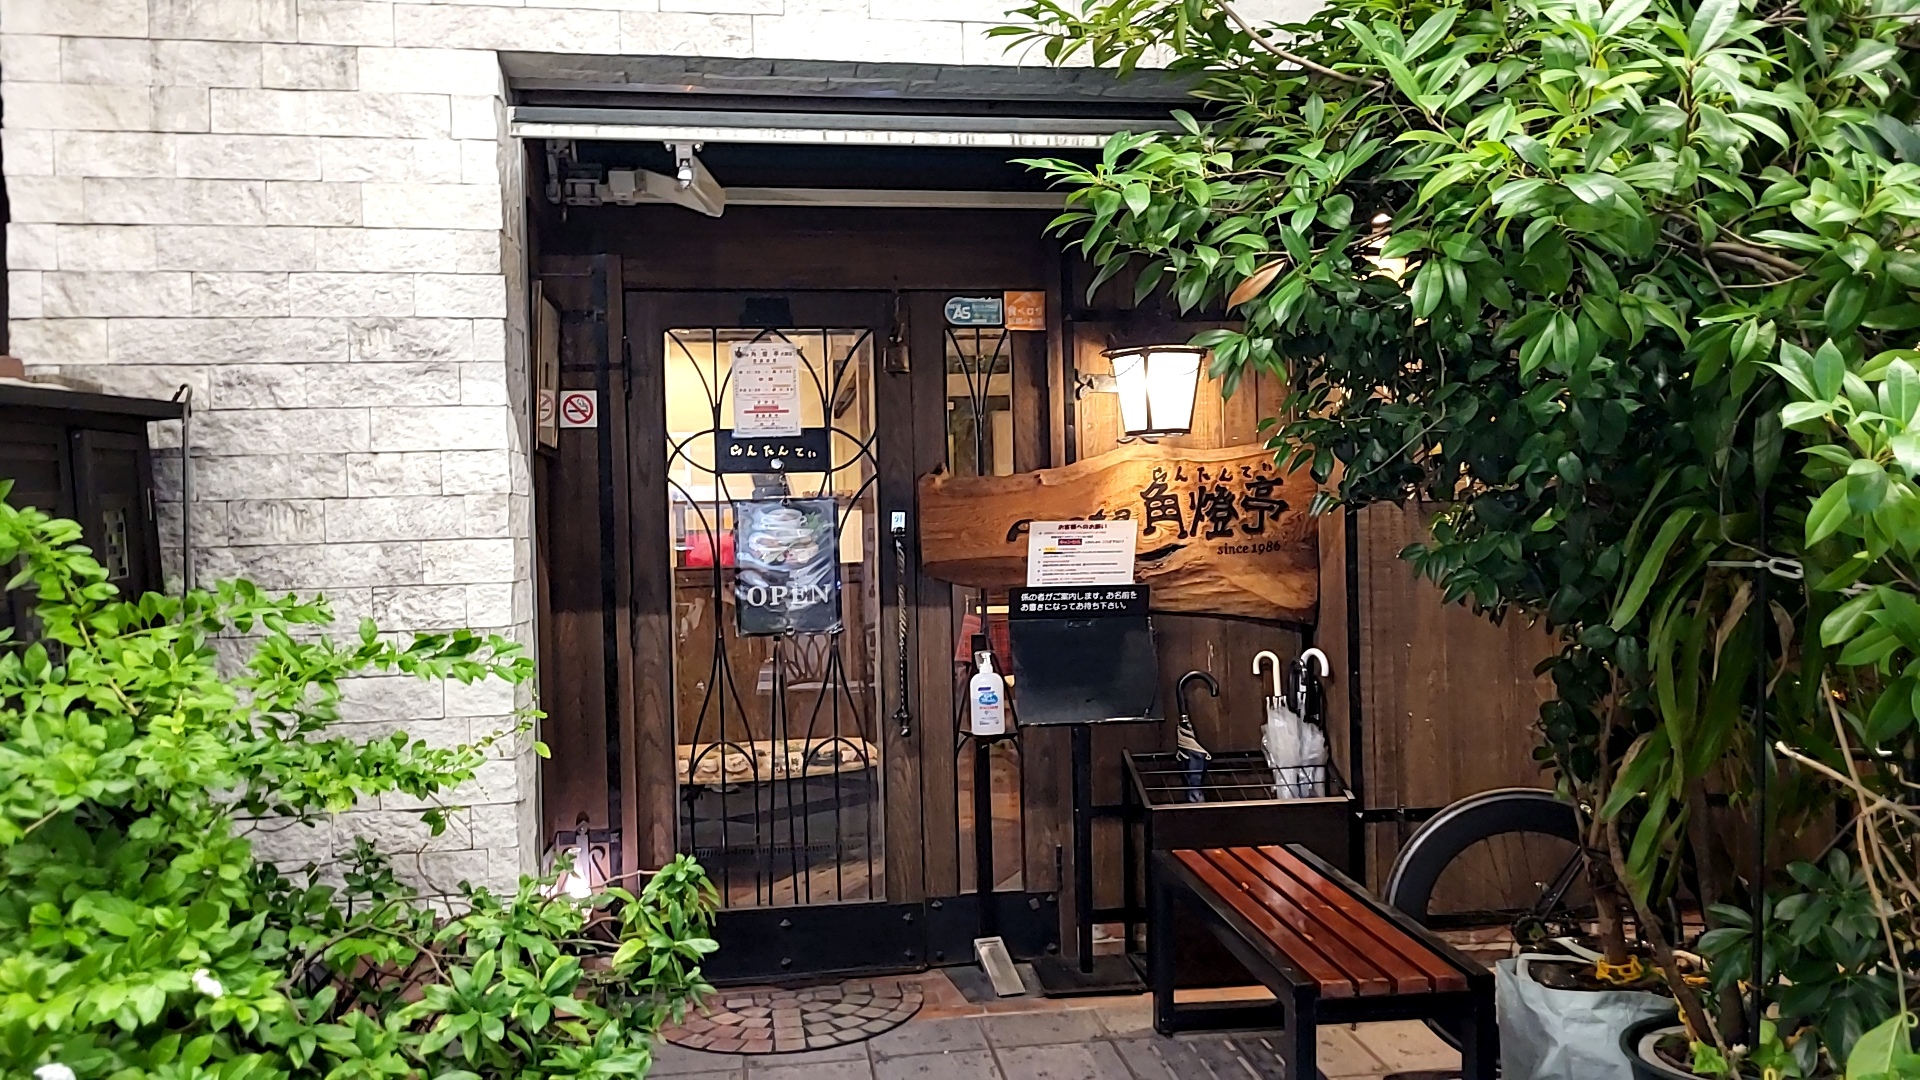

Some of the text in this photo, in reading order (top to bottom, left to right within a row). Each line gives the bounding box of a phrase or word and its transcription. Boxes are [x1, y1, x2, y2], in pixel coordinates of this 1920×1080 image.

[1217, 540, 1281, 556] since 1986
[746, 583, 832, 608] OPEN
[1020, 590, 1138, 602] 係の者がご案内します。お名前を
